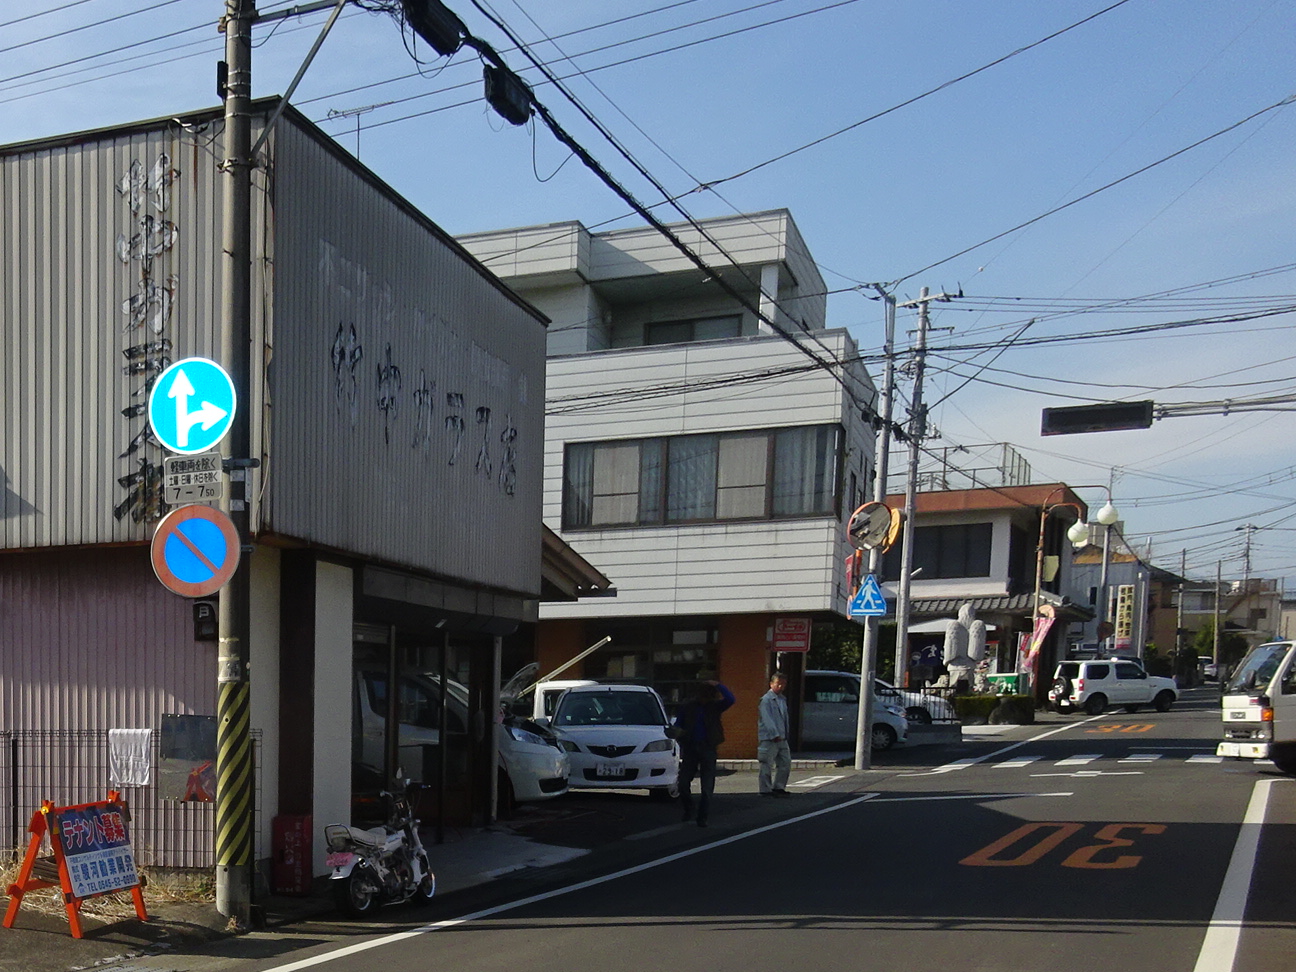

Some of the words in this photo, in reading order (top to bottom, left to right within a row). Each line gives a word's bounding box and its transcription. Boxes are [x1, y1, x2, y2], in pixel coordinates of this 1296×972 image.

[170, 457, 216, 473] 軽車両を除く
[1084, 724, 1157, 733] 30
[62, 812, 126, 850] テナント募集
[958, 822, 1168, 869] 30
[87, 882, 99, 892] TEL
